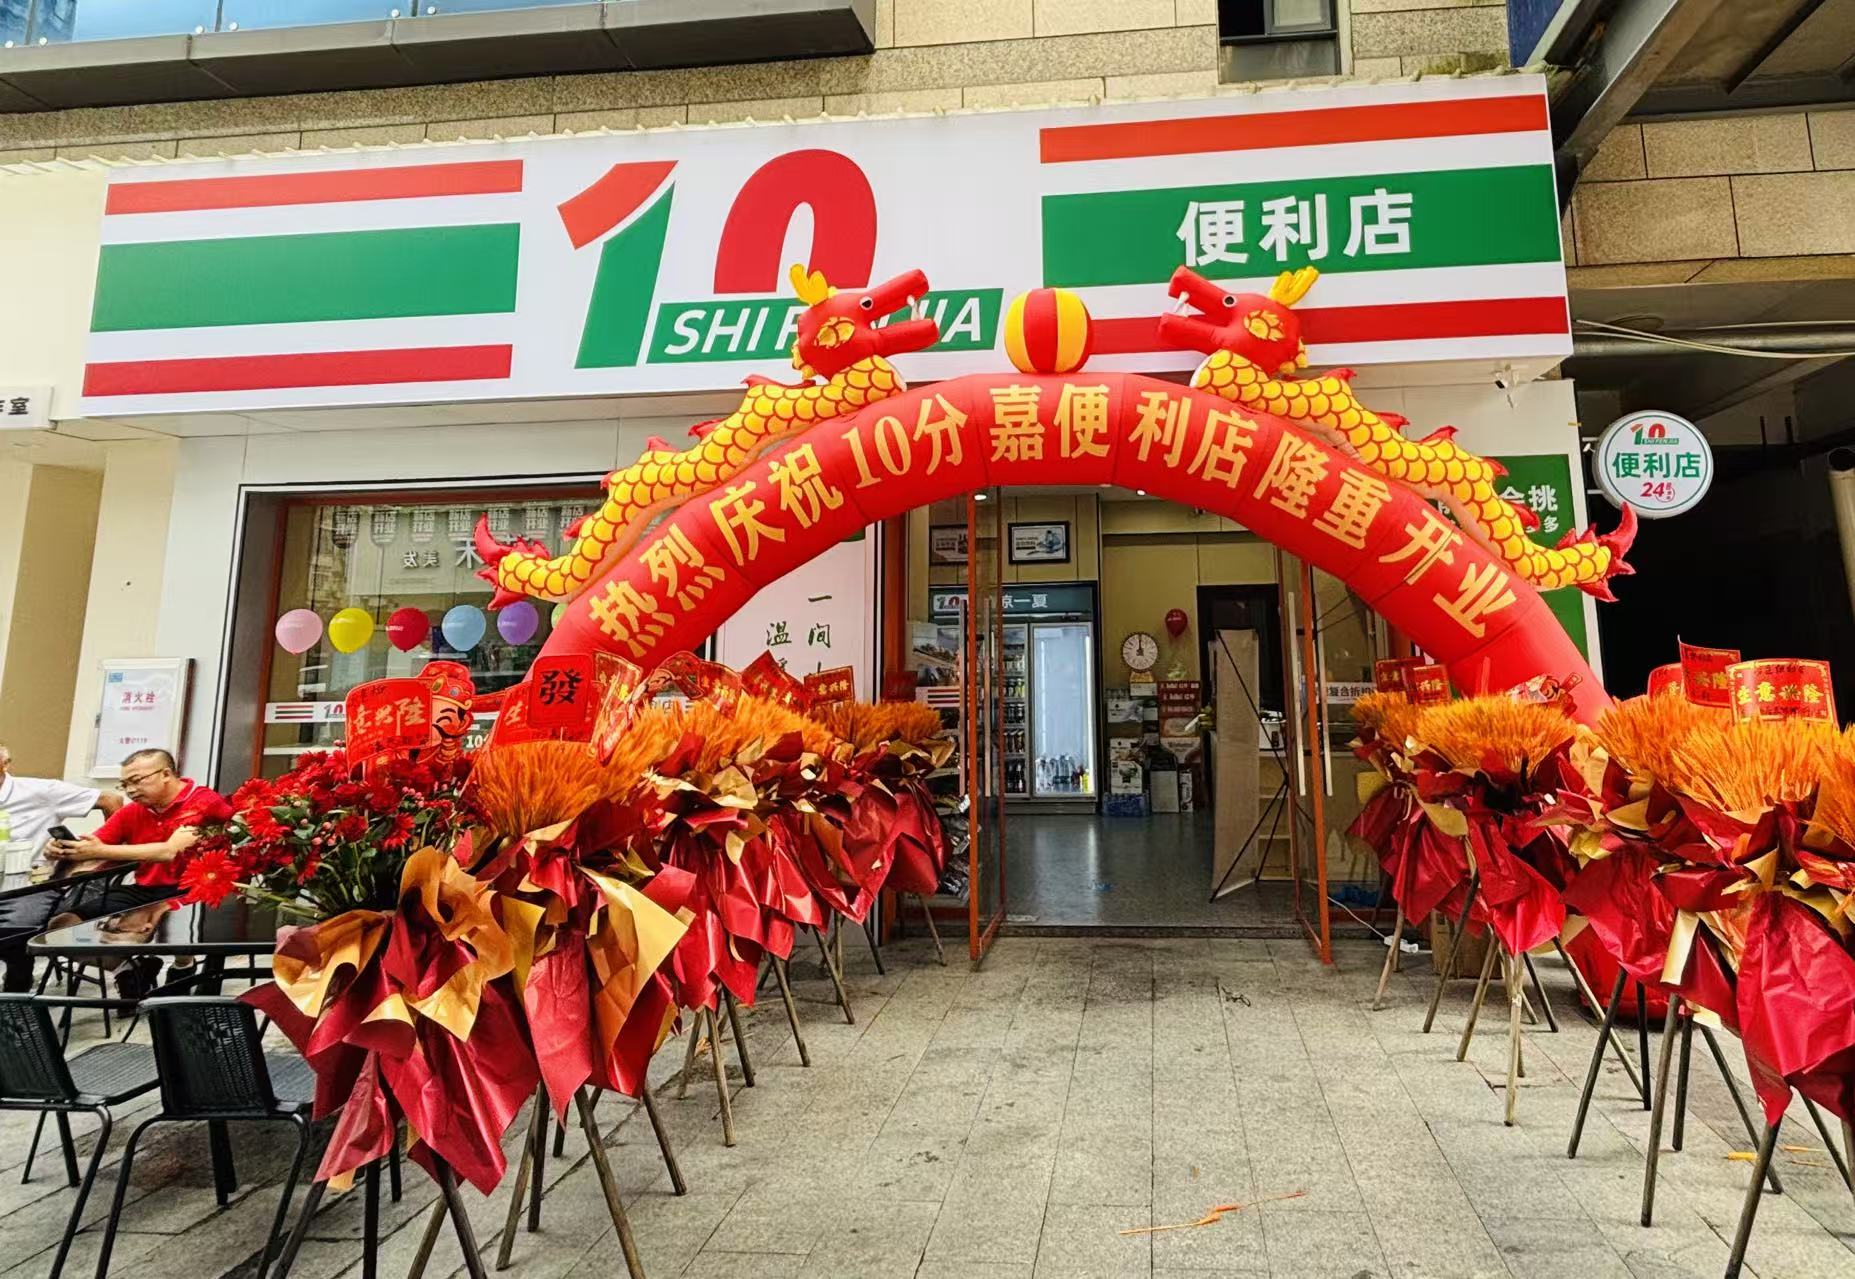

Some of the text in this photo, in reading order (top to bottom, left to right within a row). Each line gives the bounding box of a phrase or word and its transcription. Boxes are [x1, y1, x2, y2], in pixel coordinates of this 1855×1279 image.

[1175, 187, 1414, 267] 便利店
[663, 306, 770, 356] SHI
[1612, 452, 1701, 478] 便利店
[1640, 482, 1665, 497] 24
[540, 668, 582, 705] 發
[466, 734, 487, 749] 10
